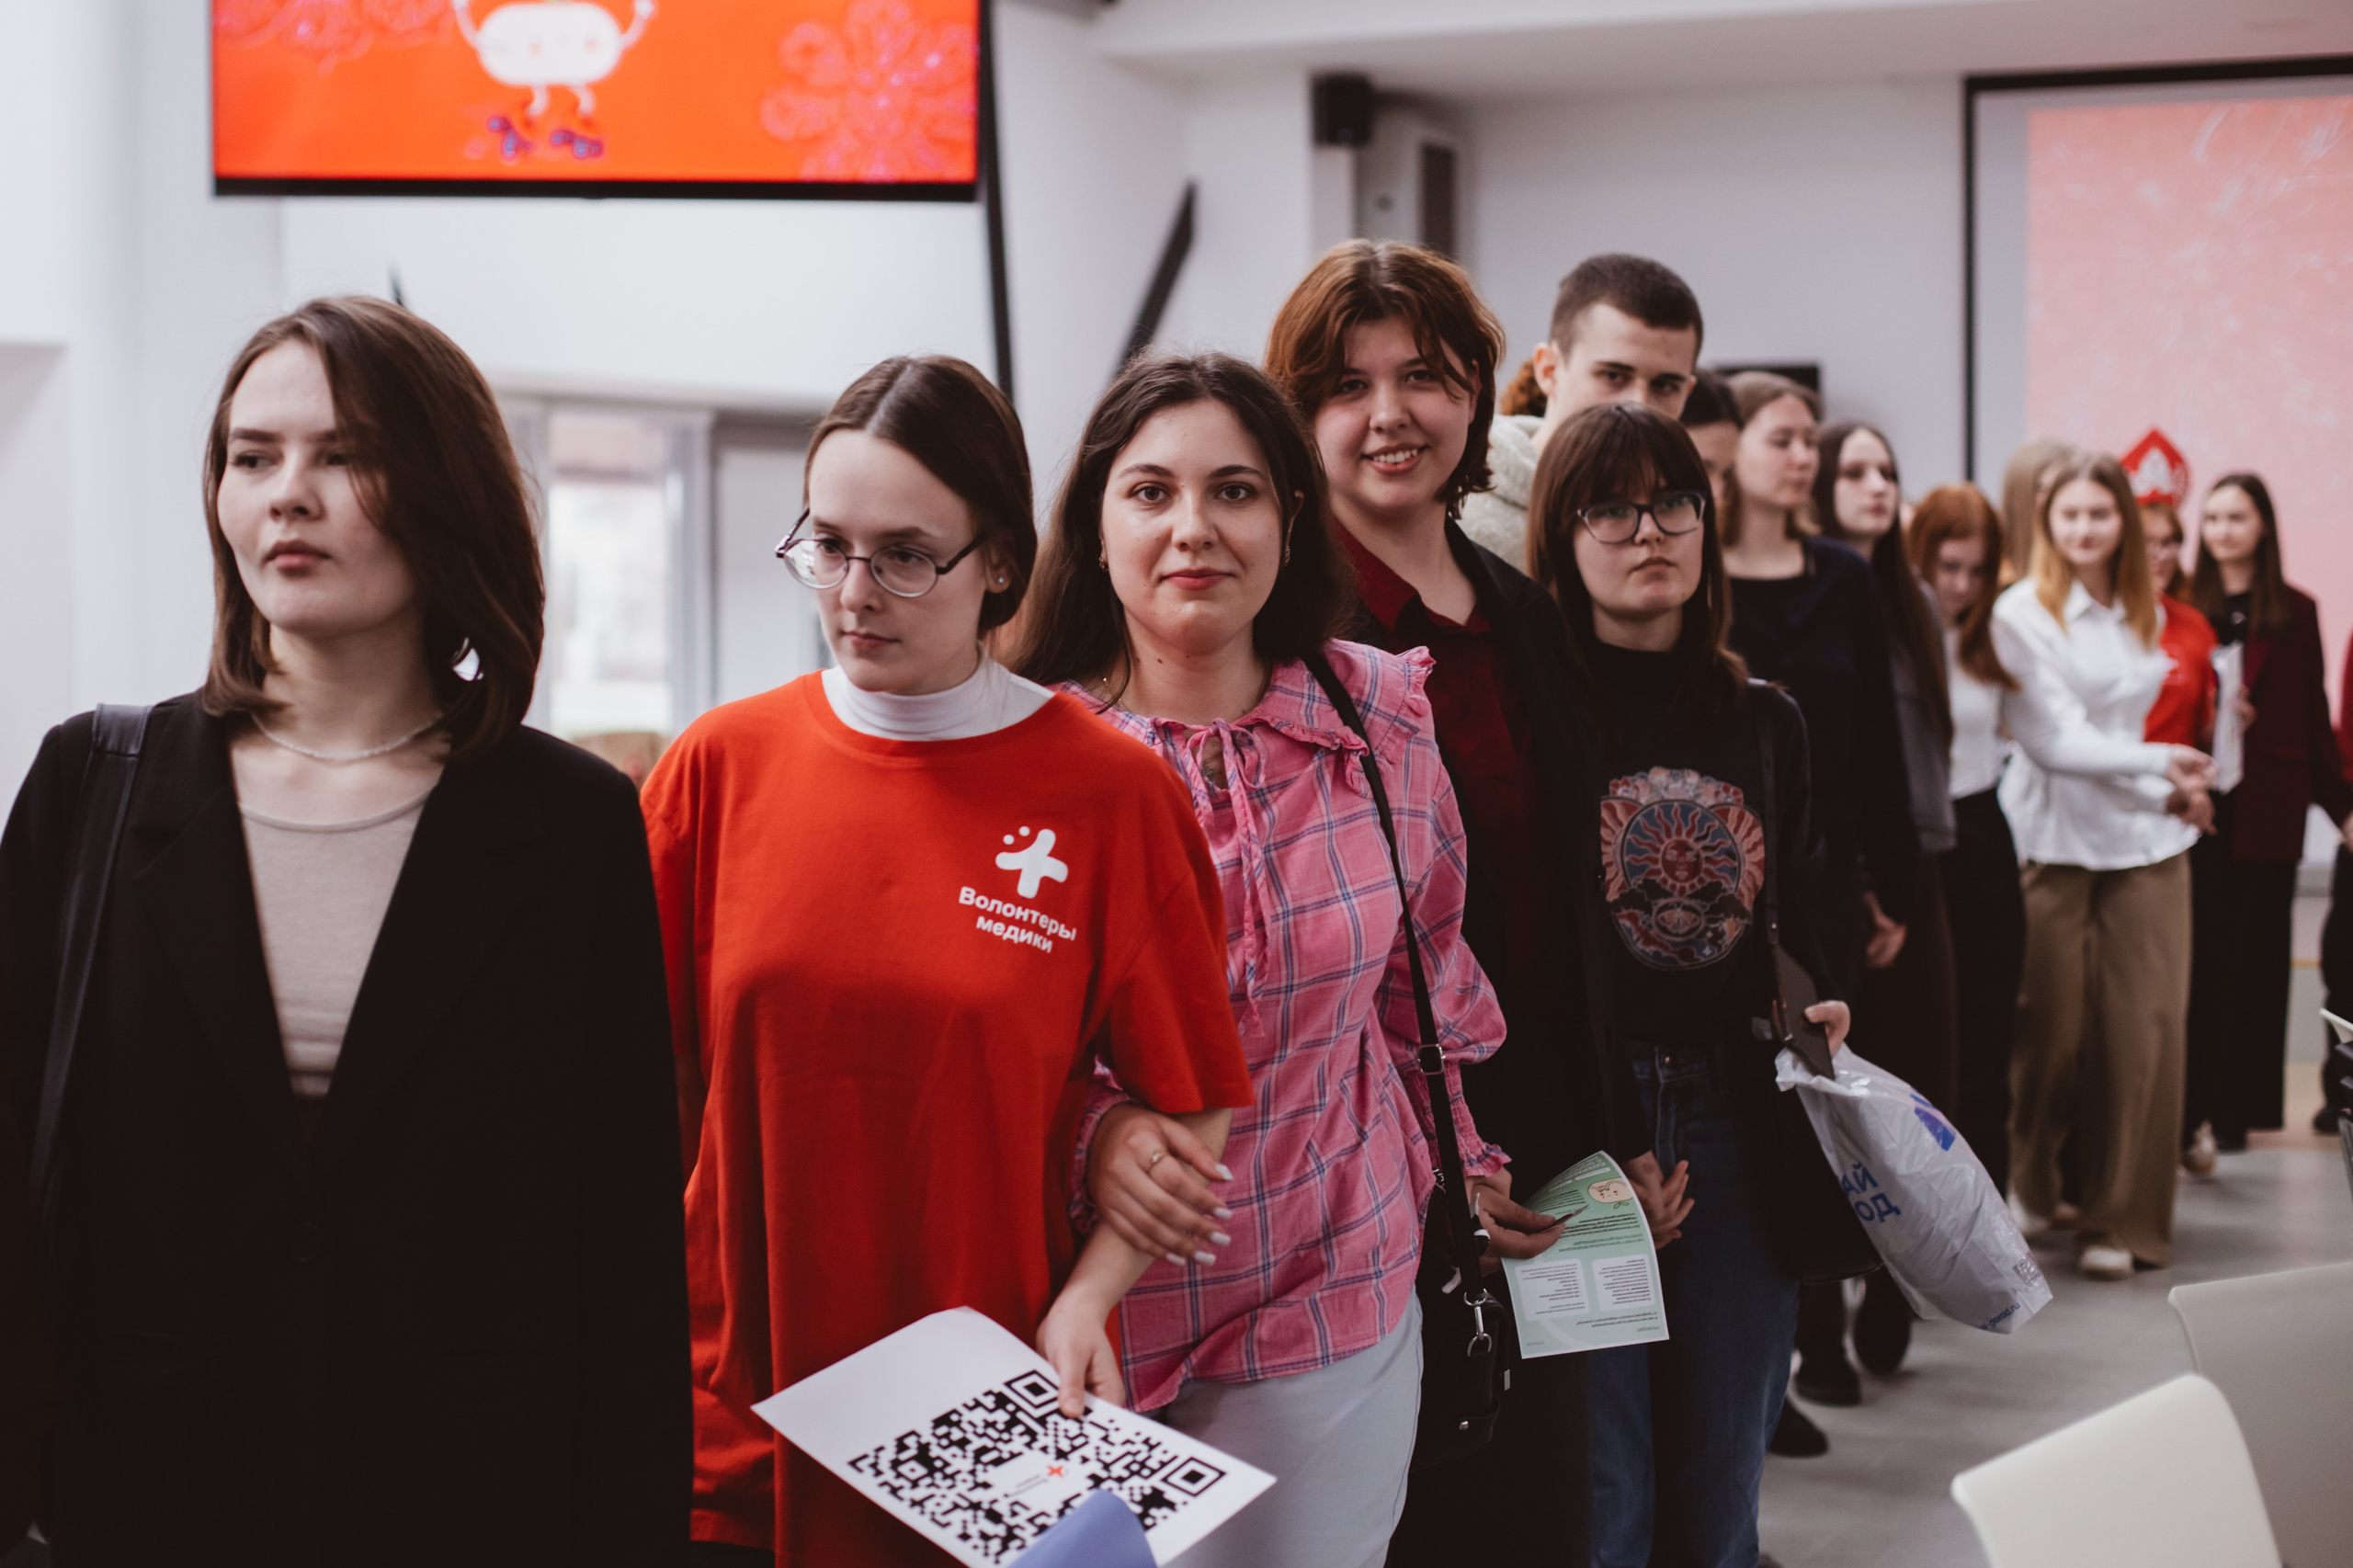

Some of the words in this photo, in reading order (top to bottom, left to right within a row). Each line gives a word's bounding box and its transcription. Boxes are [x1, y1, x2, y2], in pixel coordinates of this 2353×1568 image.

[959, 886, 1077, 941] Волонтеры
[976, 915, 1053, 953] медики
[1840, 1161, 1879, 1196] АЙ
[1854, 1192, 1902, 1222] ОД
